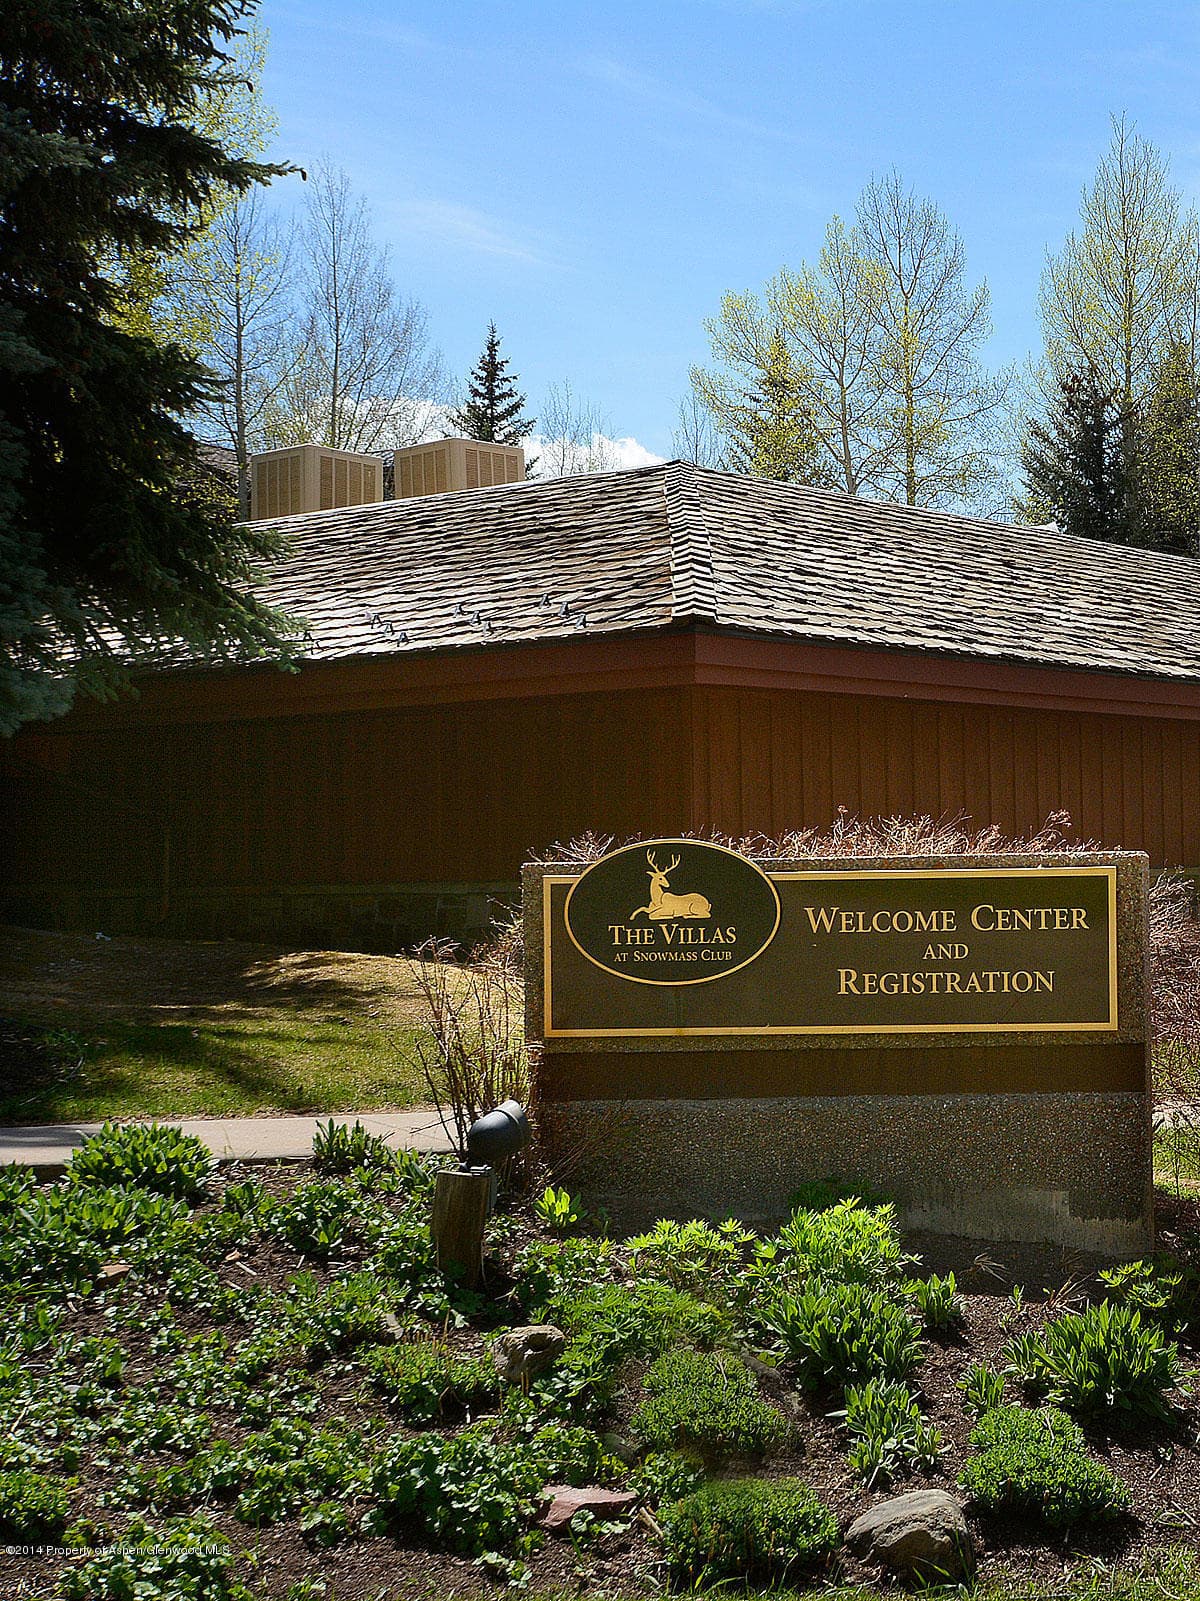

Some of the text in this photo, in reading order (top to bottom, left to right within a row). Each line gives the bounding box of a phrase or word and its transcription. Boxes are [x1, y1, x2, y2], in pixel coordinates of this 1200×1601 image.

[804, 904, 1090, 933] WELCOME CENTER
[608, 923, 737, 945] THE VILLAS
[613, 949, 732, 962] AT SNOWMASS CLUB
[922, 943, 969, 960] AND
[837, 968, 1055, 995] REGISTRATION
